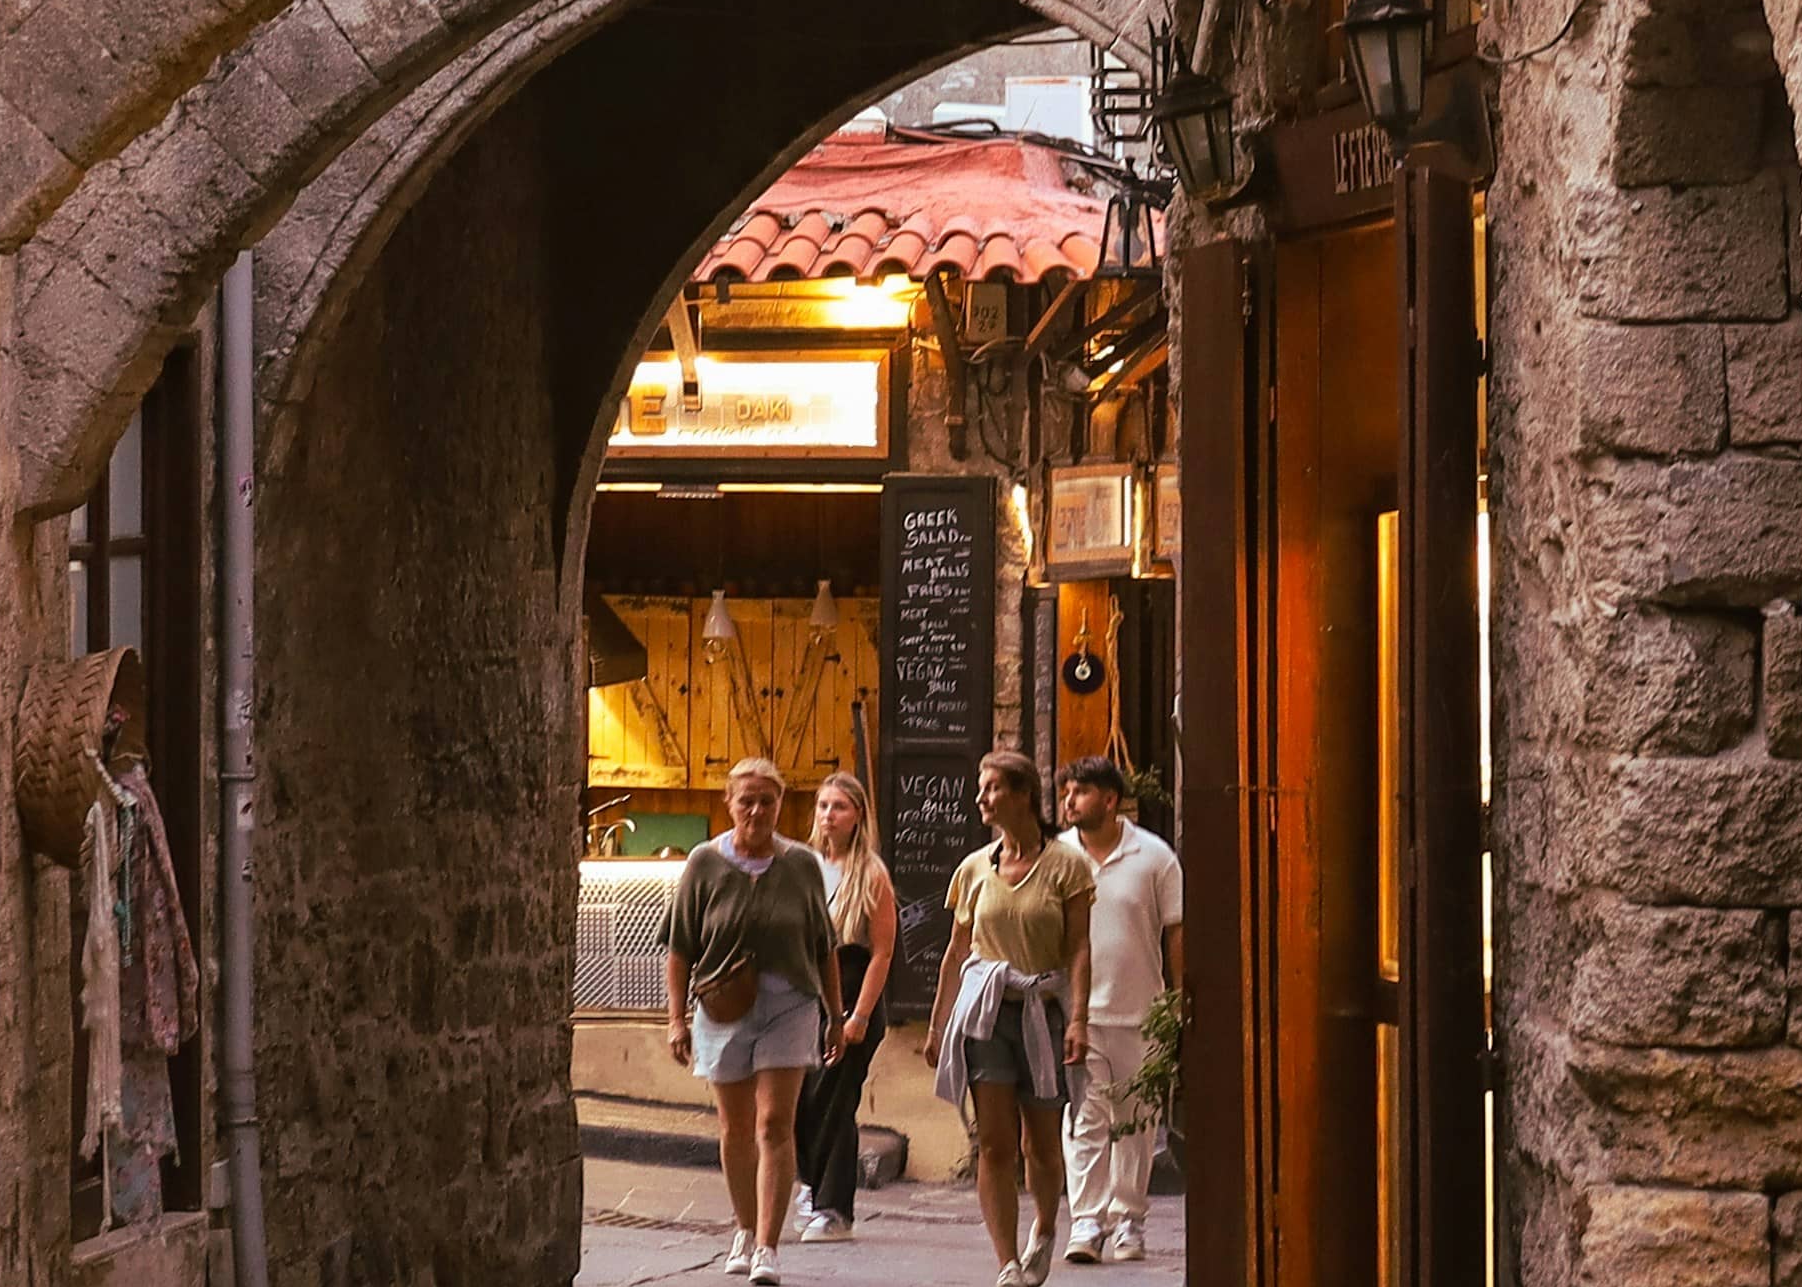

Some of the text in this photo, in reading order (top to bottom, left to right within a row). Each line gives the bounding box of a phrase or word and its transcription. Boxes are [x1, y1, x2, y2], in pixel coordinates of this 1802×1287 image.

[903, 508, 957, 531] GREEK
[905, 528, 959, 548] SALAD
[901, 556, 945, 574] MEAT
[929, 563, 970, 579] BALLS
[907, 584, 953, 598] FRIES
[896, 662, 946, 681] VEGAN
[900, 775, 966, 800] VEGAN
[920, 798, 960, 813] BALLS
